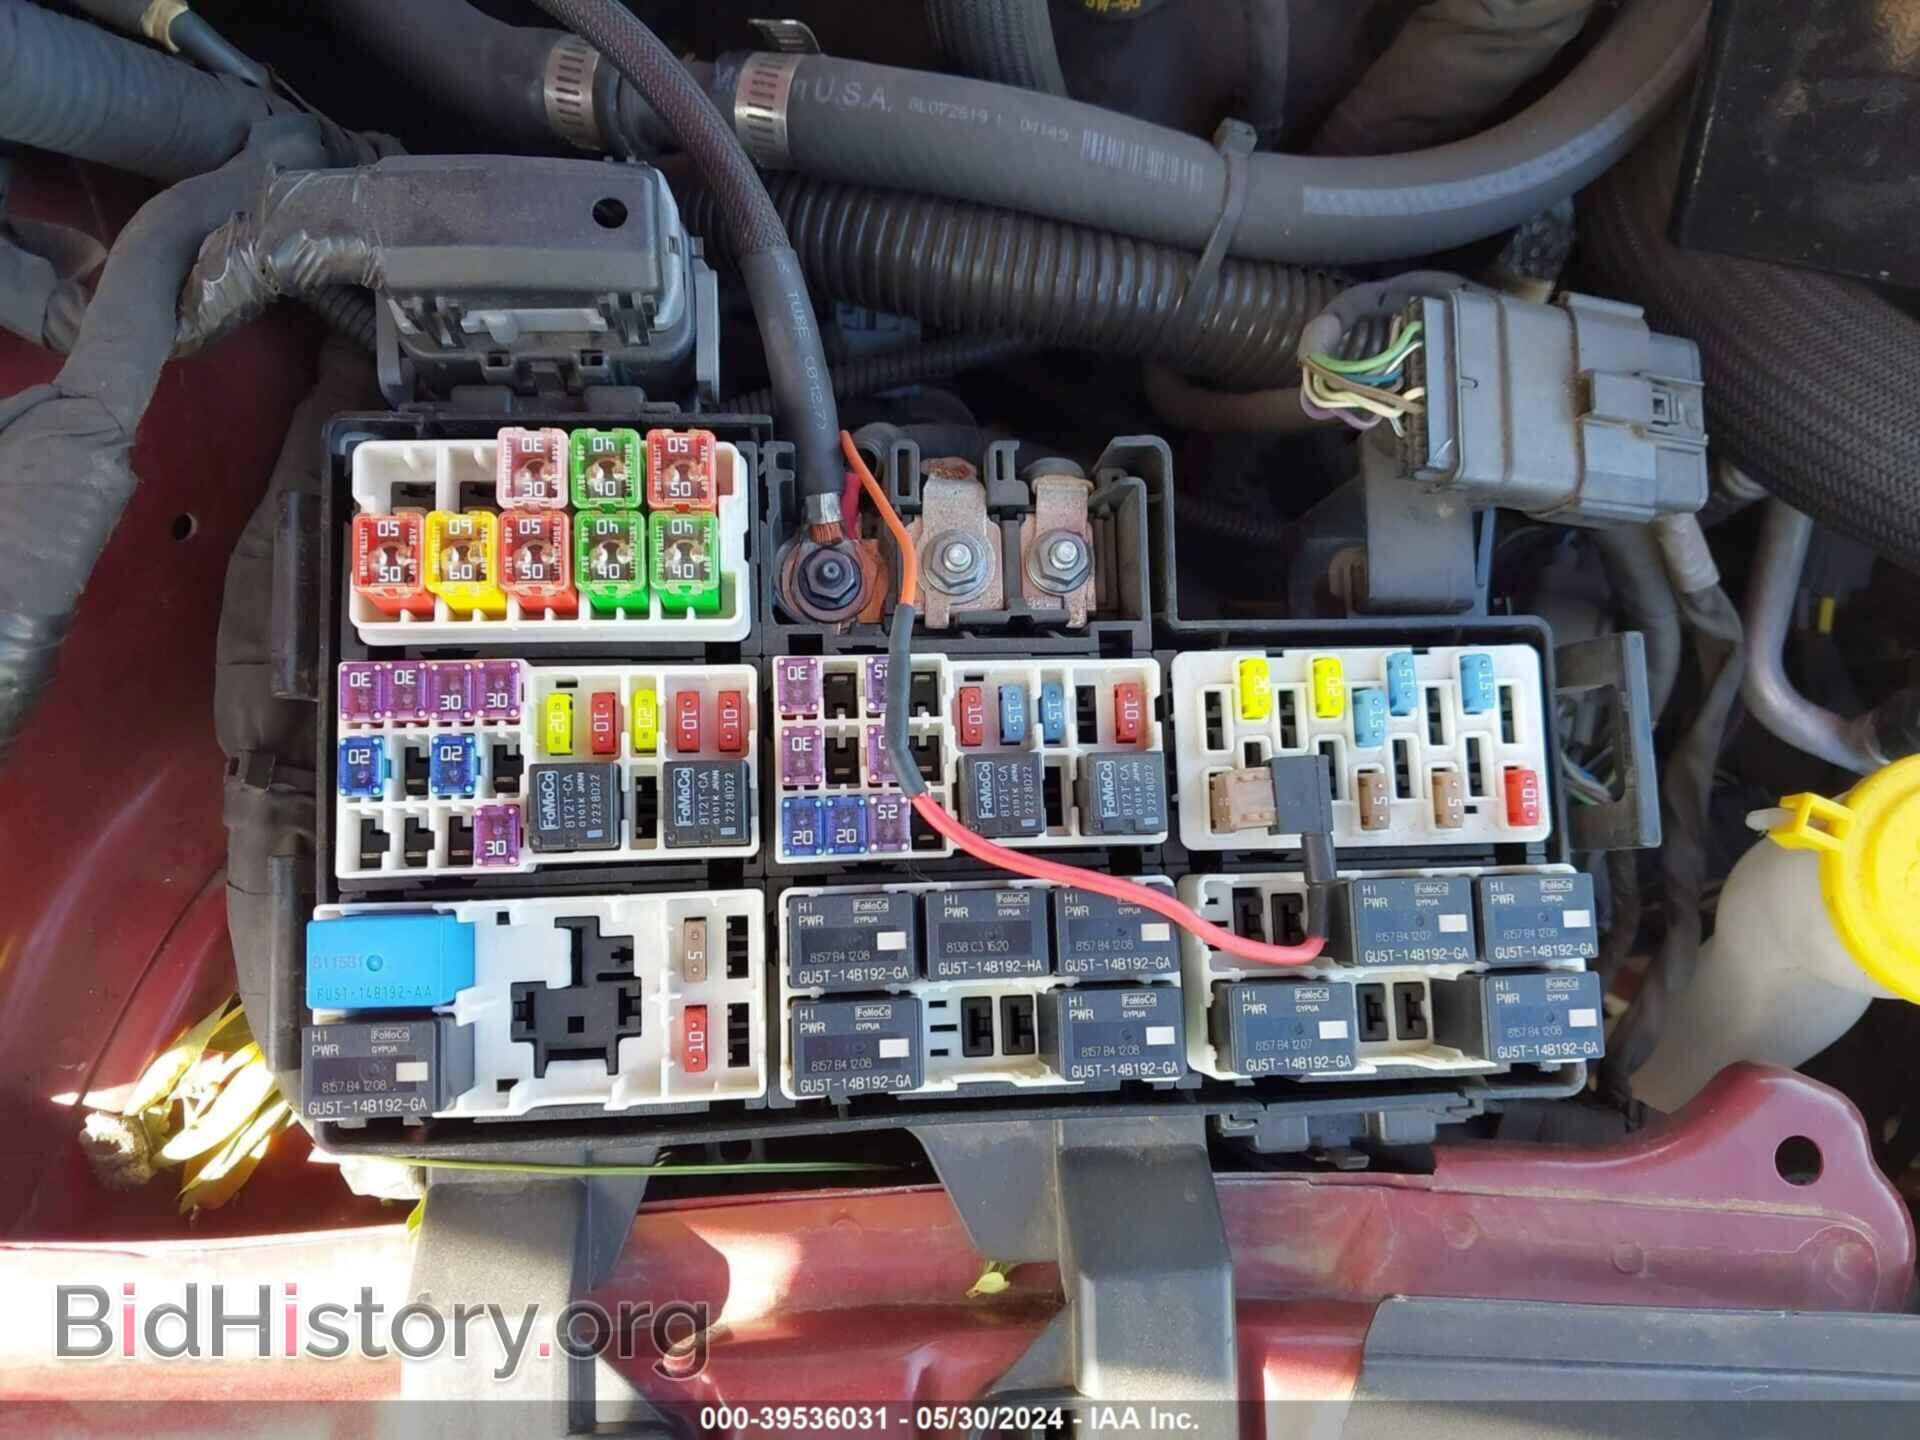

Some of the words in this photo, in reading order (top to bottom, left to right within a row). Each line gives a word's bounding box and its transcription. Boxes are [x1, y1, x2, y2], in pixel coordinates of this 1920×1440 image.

[523, 482, 544, 497] 30
[594, 481, 616, 496] 40
[669, 482, 691, 496] 50
[378, 566, 400, 582] 50
[449, 564, 472, 580] 60
[521, 564, 543, 579] 50
[597, 564, 619, 579] 40
[672, 564, 694, 578] 40
[439, 694, 461, 710] 30
[486, 693, 508, 708] 30
[968, 706, 983, 725] 10
[1008, 704, 1023, 723] 15
[1047, 700, 1063, 720] 15
[1123, 700, 1139, 720] 10
[594, 712, 608, 732] 10
[681, 710, 697, 730] 10
[723, 710, 738, 728] 10
[978, 764, 994, 817] FoMoCo
[1100, 763, 1116, 817] FoMoCo
[540, 771, 558, 829] FoMoCo
[676, 769, 692, 825] FoMoCo
[1374, 796, 1387, 806] 5
[1448, 795, 1461, 807] 5
[1522, 787, 1537, 809] 10
[793, 830, 814, 845] 20
[836, 829, 857, 843] 20
[485, 840, 506, 856] 30
[1362, 885, 1376, 895] HI
[1490, 882, 1504, 892] HI
[943, 895, 958, 905] HI
[997, 893, 1030, 905] FoMoCo
[1064, 893, 1078, 904] HI
[1363, 897, 1388, 908] PWR
[1491, 894, 1515, 905] PWR
[798, 902, 813, 913] HI
[854, 899, 888, 912] FoMoCo
[1065, 906, 1089, 917] PWR
[944, 907, 968, 919] PWR
[798, 915, 824, 927] PWR
[687, 950, 703, 961] 5
[1496, 980, 1510, 991] HI
[1068, 996, 1082, 1007] HI
[1122, 993, 1156, 1006] FoMoCo
[1242, 991, 1255, 1001] HI
[1496, 993, 1520, 1004] PWR
[800, 1009, 814, 1019] HI
[856, 1005, 890, 1018] FoMoCo
[1069, 1009, 1094, 1020] PWR
[1243, 1004, 1267, 1015] PWR
[800, 1022, 825, 1033] PWR
[311, 1030, 327, 1042] HI
[371, 1028, 409, 1041] FoMoCo
[689, 1031, 705, 1051] 10
[312, 1044, 339, 1056] PWR
